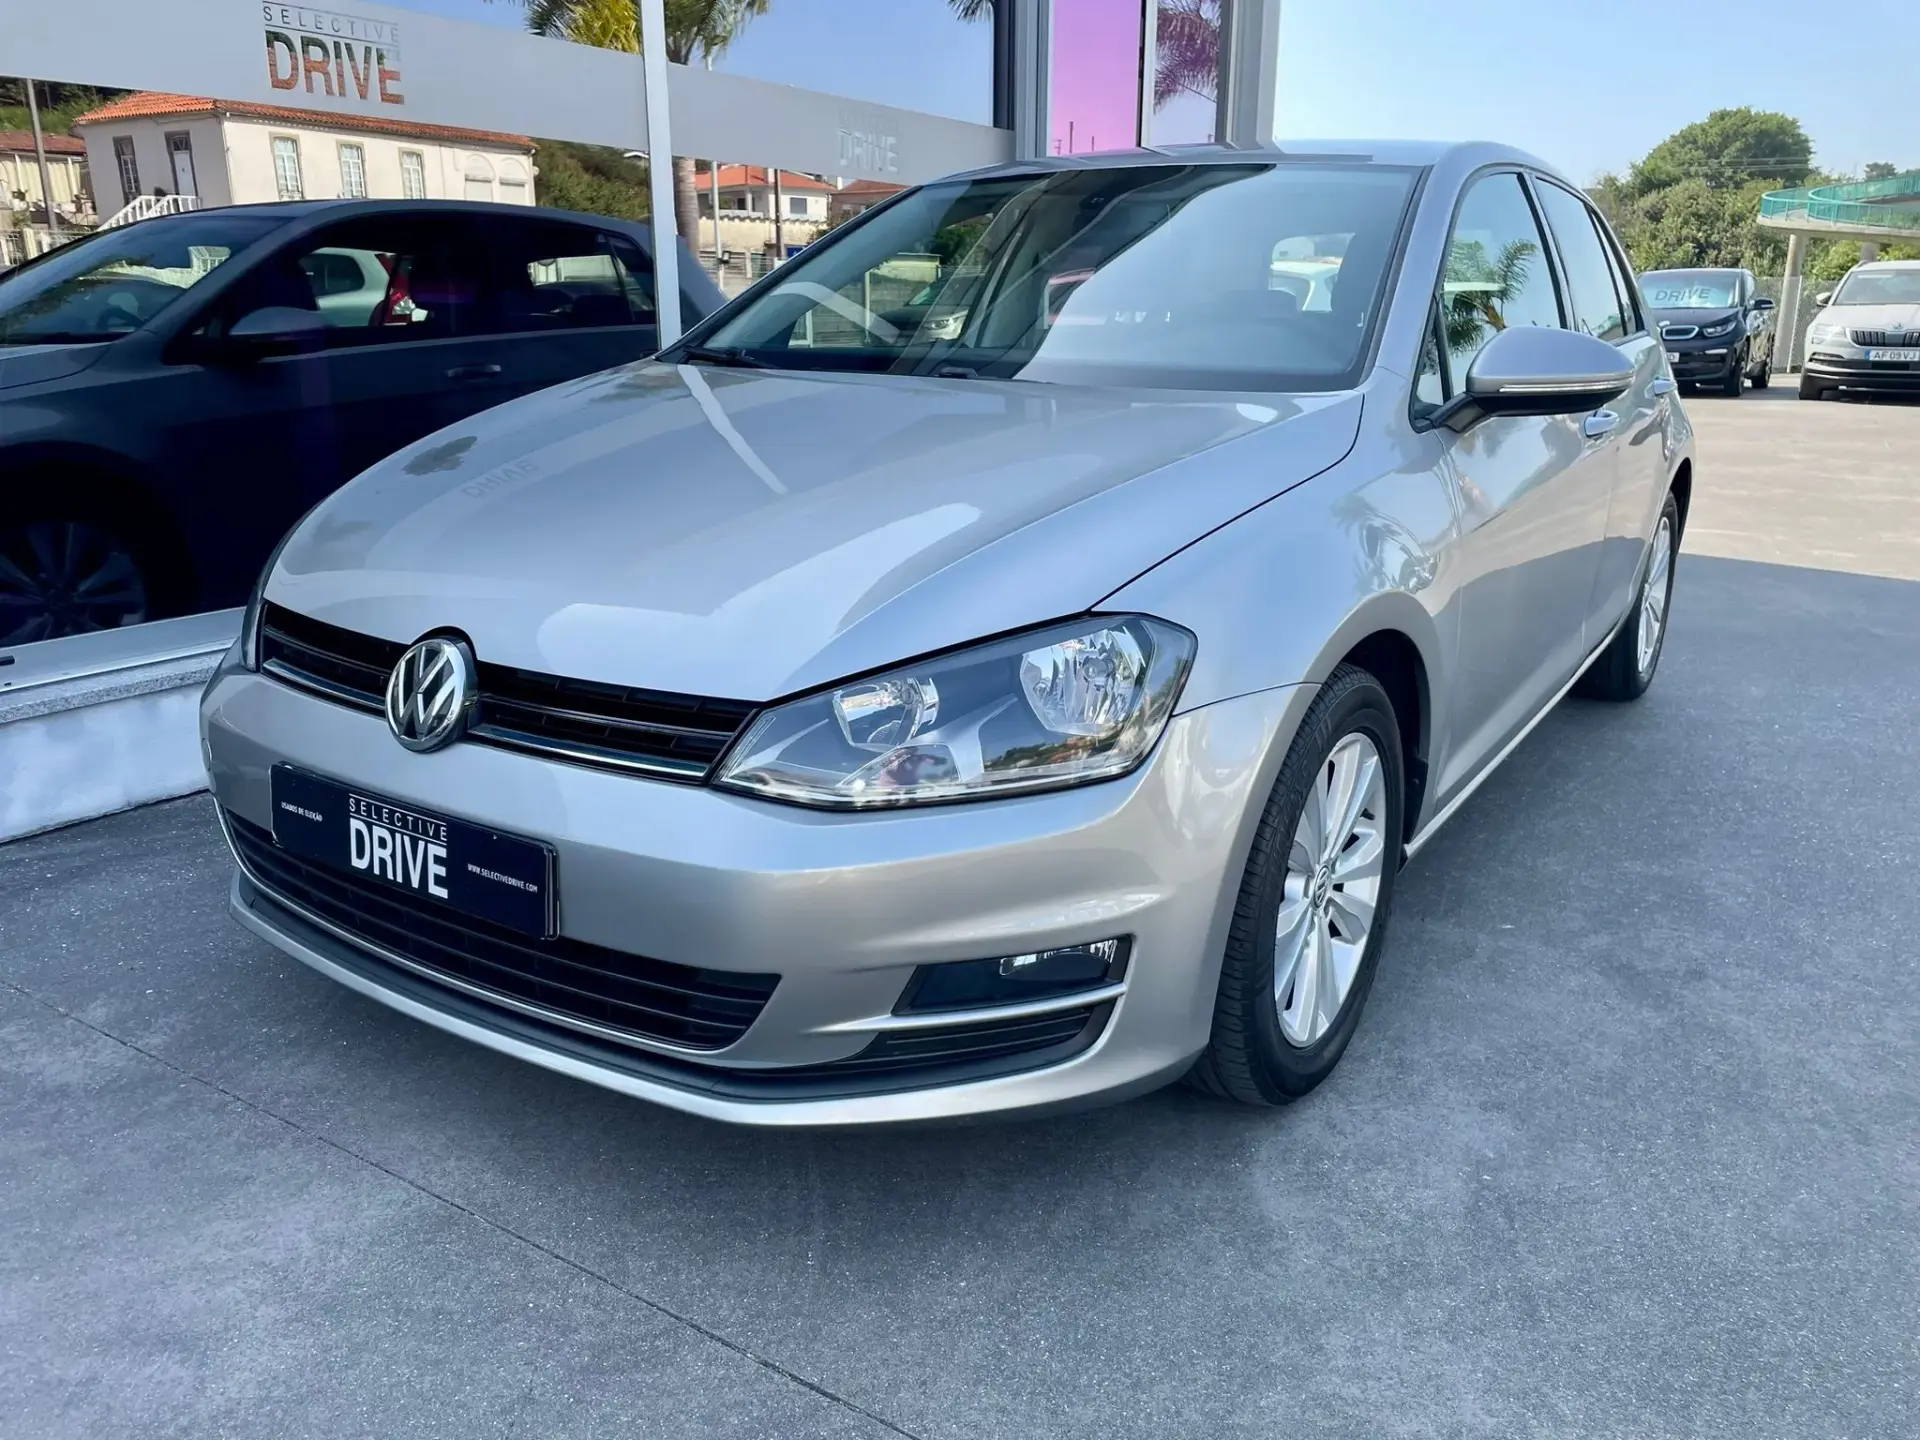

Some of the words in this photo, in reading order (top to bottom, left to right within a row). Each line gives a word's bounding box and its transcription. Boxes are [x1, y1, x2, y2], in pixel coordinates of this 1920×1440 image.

[263, 6, 399, 43] SELECTIVE
[265, 30, 405, 105] DRIVE
[1655, 288, 1711, 302] DRIVE
[349, 798, 447, 841] SELECTIVE
[350, 817, 448, 899] DRIVE
